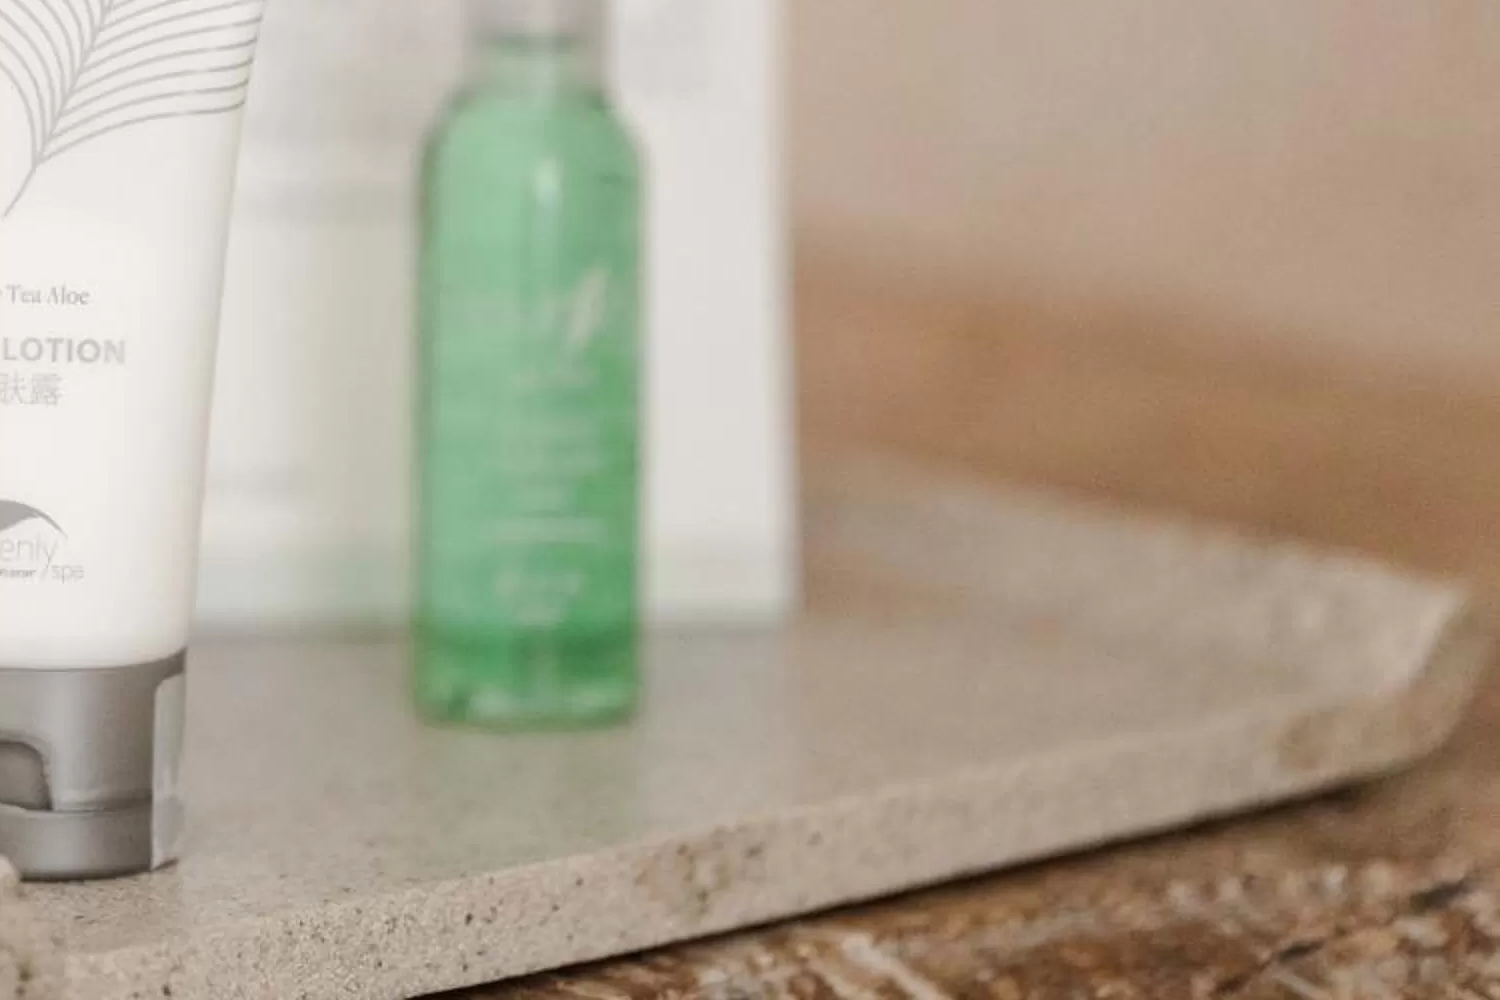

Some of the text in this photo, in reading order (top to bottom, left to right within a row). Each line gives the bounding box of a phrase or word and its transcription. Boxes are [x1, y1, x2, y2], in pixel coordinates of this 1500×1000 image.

[5, 283, 42, 304] Tea
[46, 284, 92, 306] Aloe
[3, 336, 126, 364] LOTION
